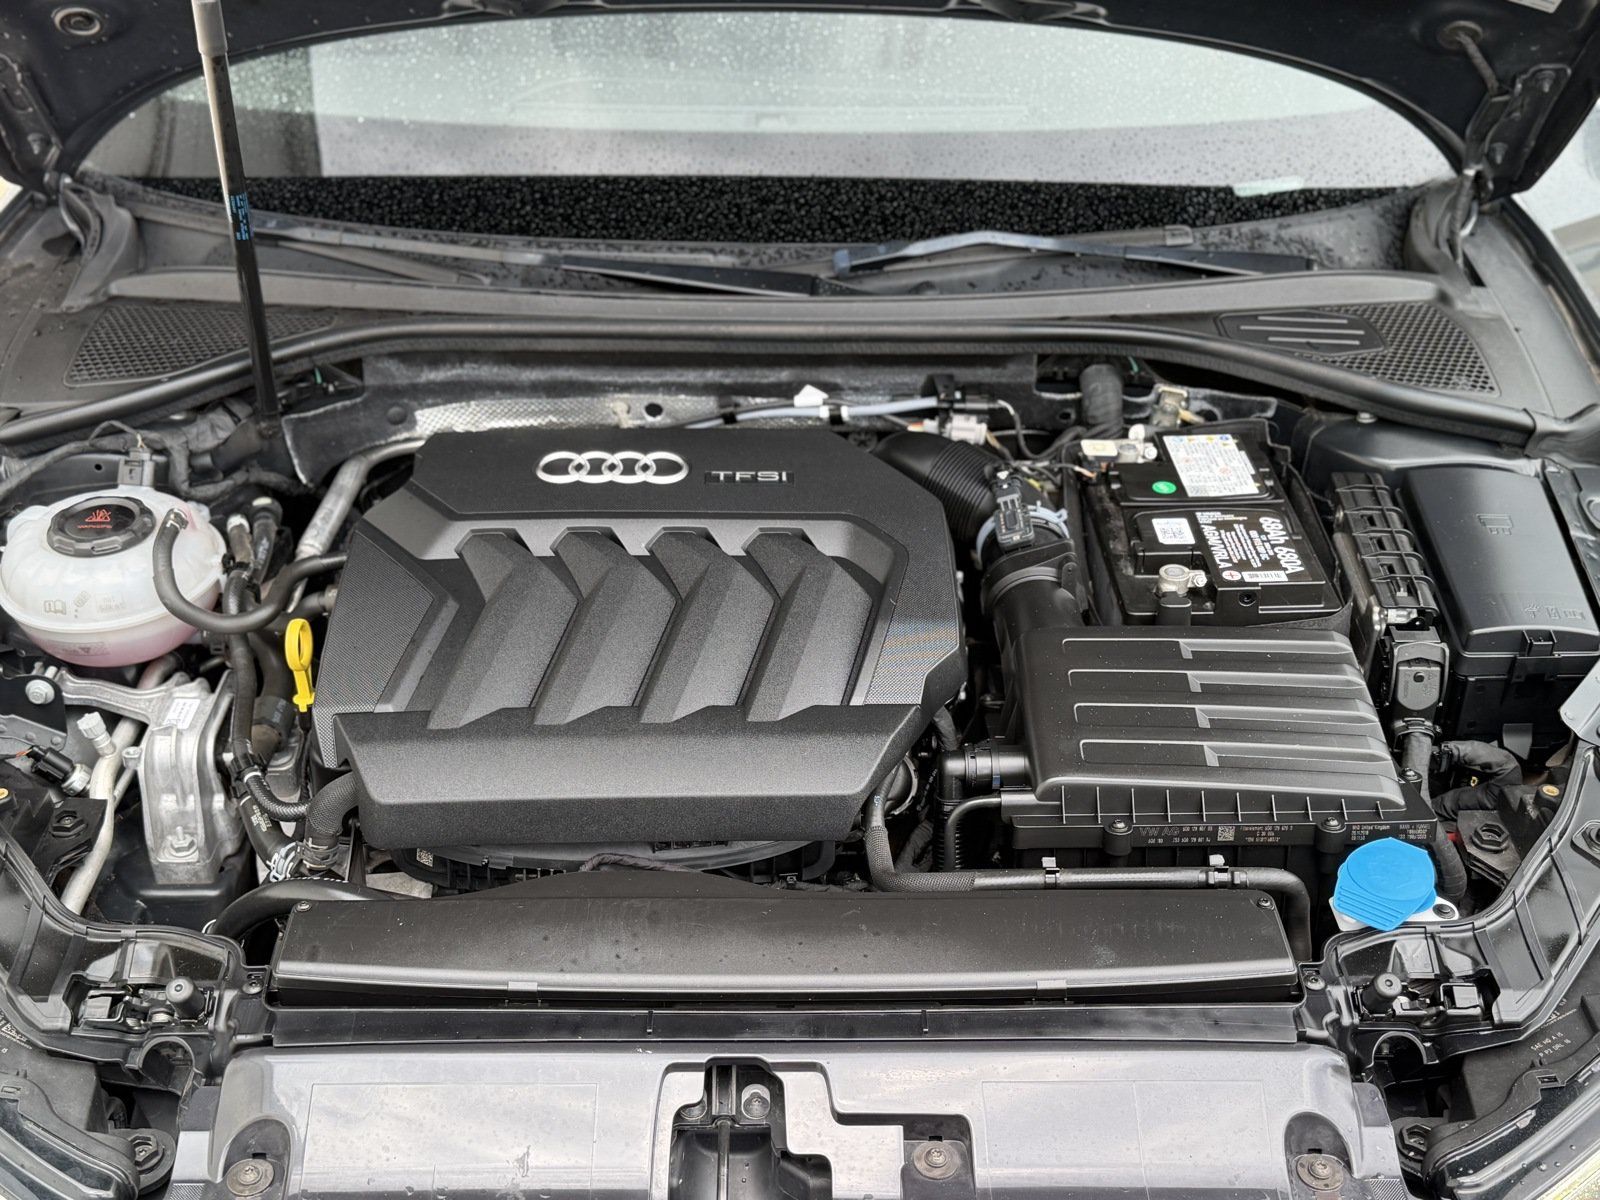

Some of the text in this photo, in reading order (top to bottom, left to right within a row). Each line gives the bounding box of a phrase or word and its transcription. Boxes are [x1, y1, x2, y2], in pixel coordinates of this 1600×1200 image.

[711, 471, 787, 481] TFSI
[1259, 517, 1289, 544] 68Ah
[1273, 546, 1305, 575] 680A
